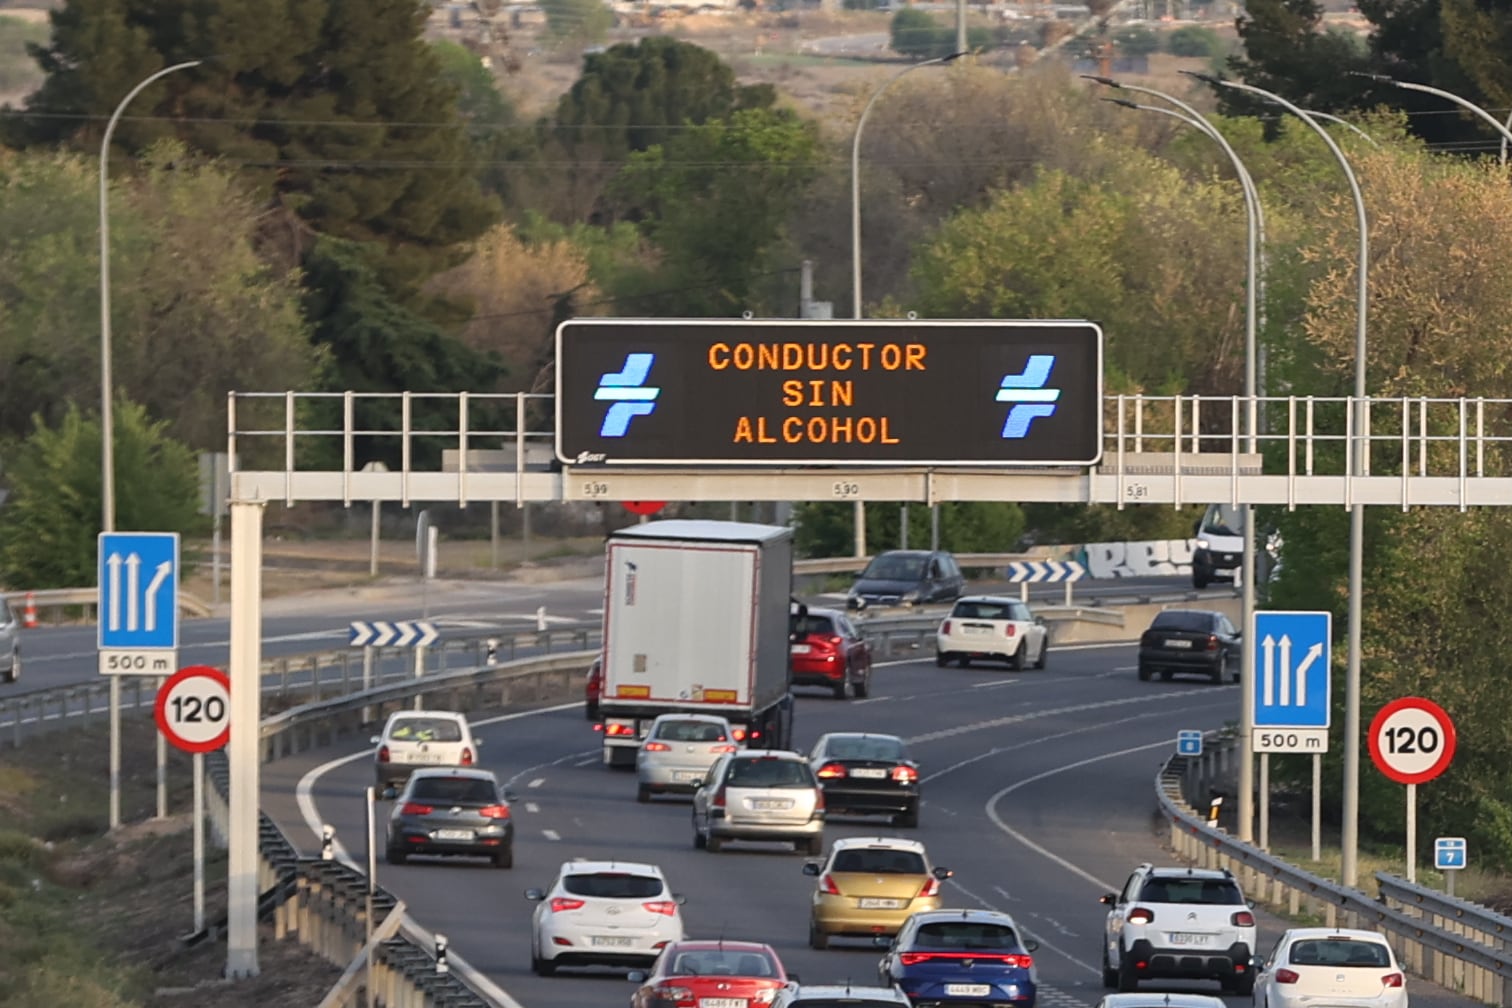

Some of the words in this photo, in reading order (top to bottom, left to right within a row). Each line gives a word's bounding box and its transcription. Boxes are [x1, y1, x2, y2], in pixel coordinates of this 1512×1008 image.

[708, 343, 926, 371] CONDUCTOR
[782, 380, 853, 407] SIN
[733, 417, 900, 444] ALCOHOL
[108, 655, 145, 669] 500
[153, 658, 167, 669] m
[171, 696, 225, 722] 120
[1261, 735, 1297, 747] 500
[1306, 737, 1320, 748] m
[1385, 727, 1438, 754] 120
[1446, 852, 1454, 863] 7
